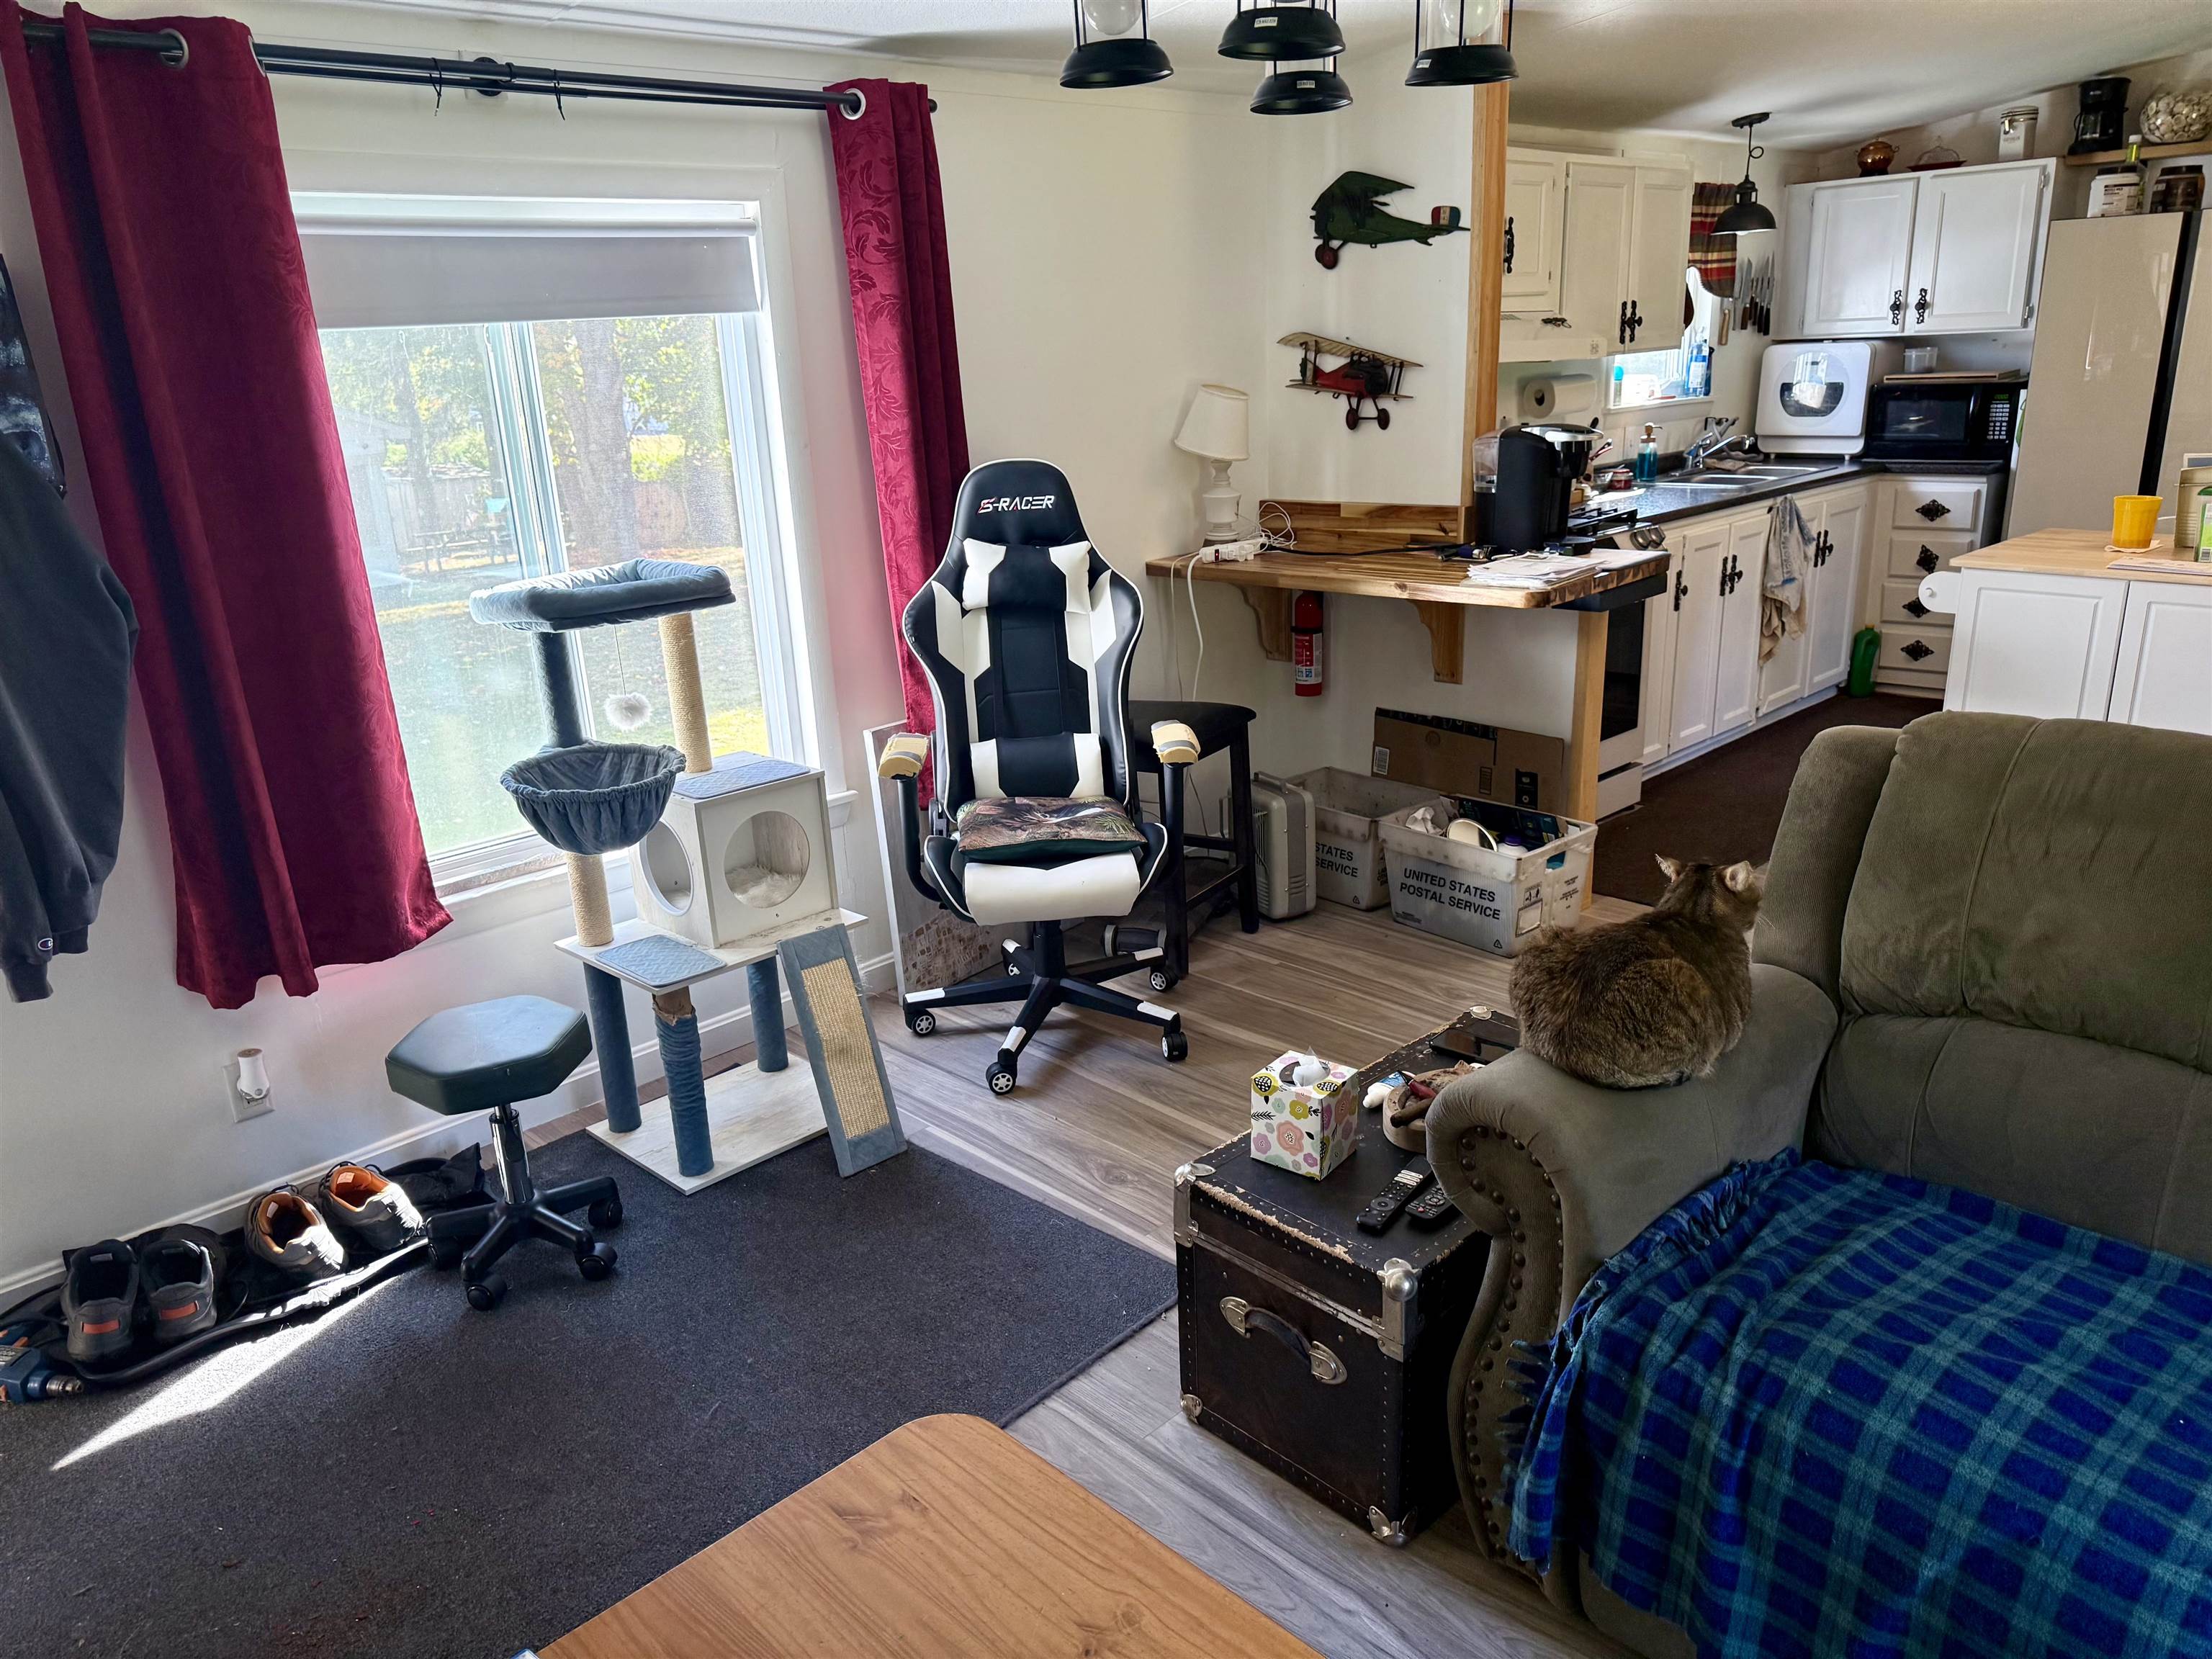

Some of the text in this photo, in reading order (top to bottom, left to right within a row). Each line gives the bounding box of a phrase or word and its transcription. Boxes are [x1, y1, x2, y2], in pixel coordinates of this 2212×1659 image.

[977, 495, 1055, 514] S-RACER
[1400, 882, 1445, 904] POSTAL
[1448, 896, 1501, 920] SERVICE
[1404, 868, 1446, 888] UNITED
[1449, 880, 1496, 902] STATES
